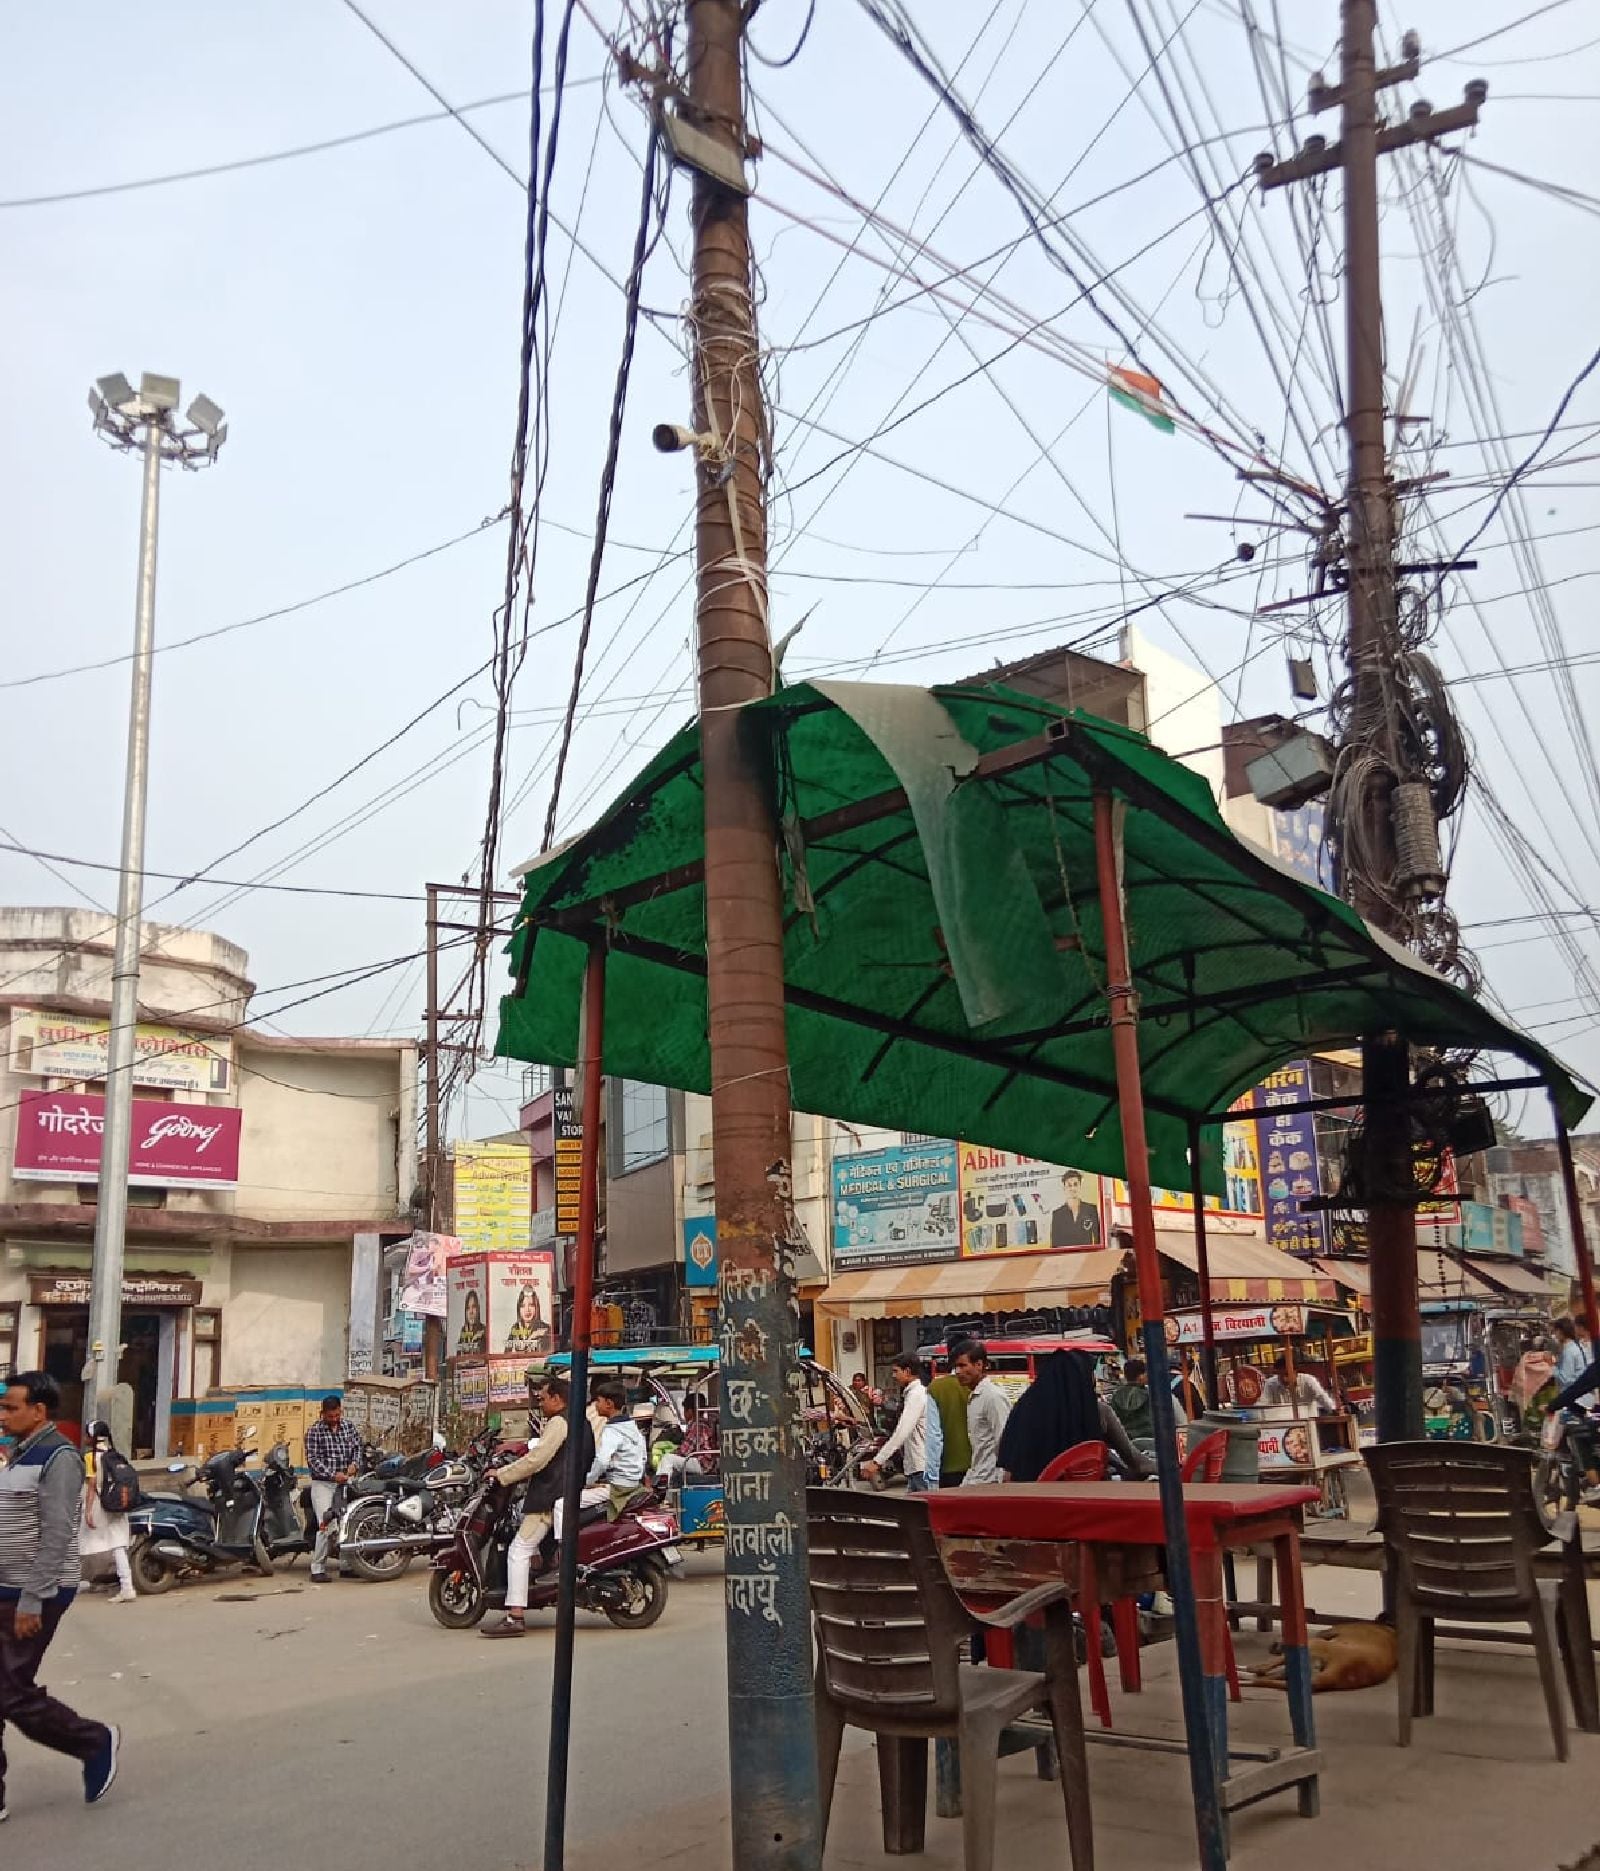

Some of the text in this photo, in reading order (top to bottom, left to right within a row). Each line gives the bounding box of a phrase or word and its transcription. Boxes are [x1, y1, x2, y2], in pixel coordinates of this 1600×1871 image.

[1265, 1091, 1298, 1107] केक
[141, 1114, 223, 1153] Godrej
[1267, 1129, 1304, 1147] केक
[840, 1172, 951, 1196] MEDICAL & SURGICAL
[1183, 1323, 1198, 1335] A1
